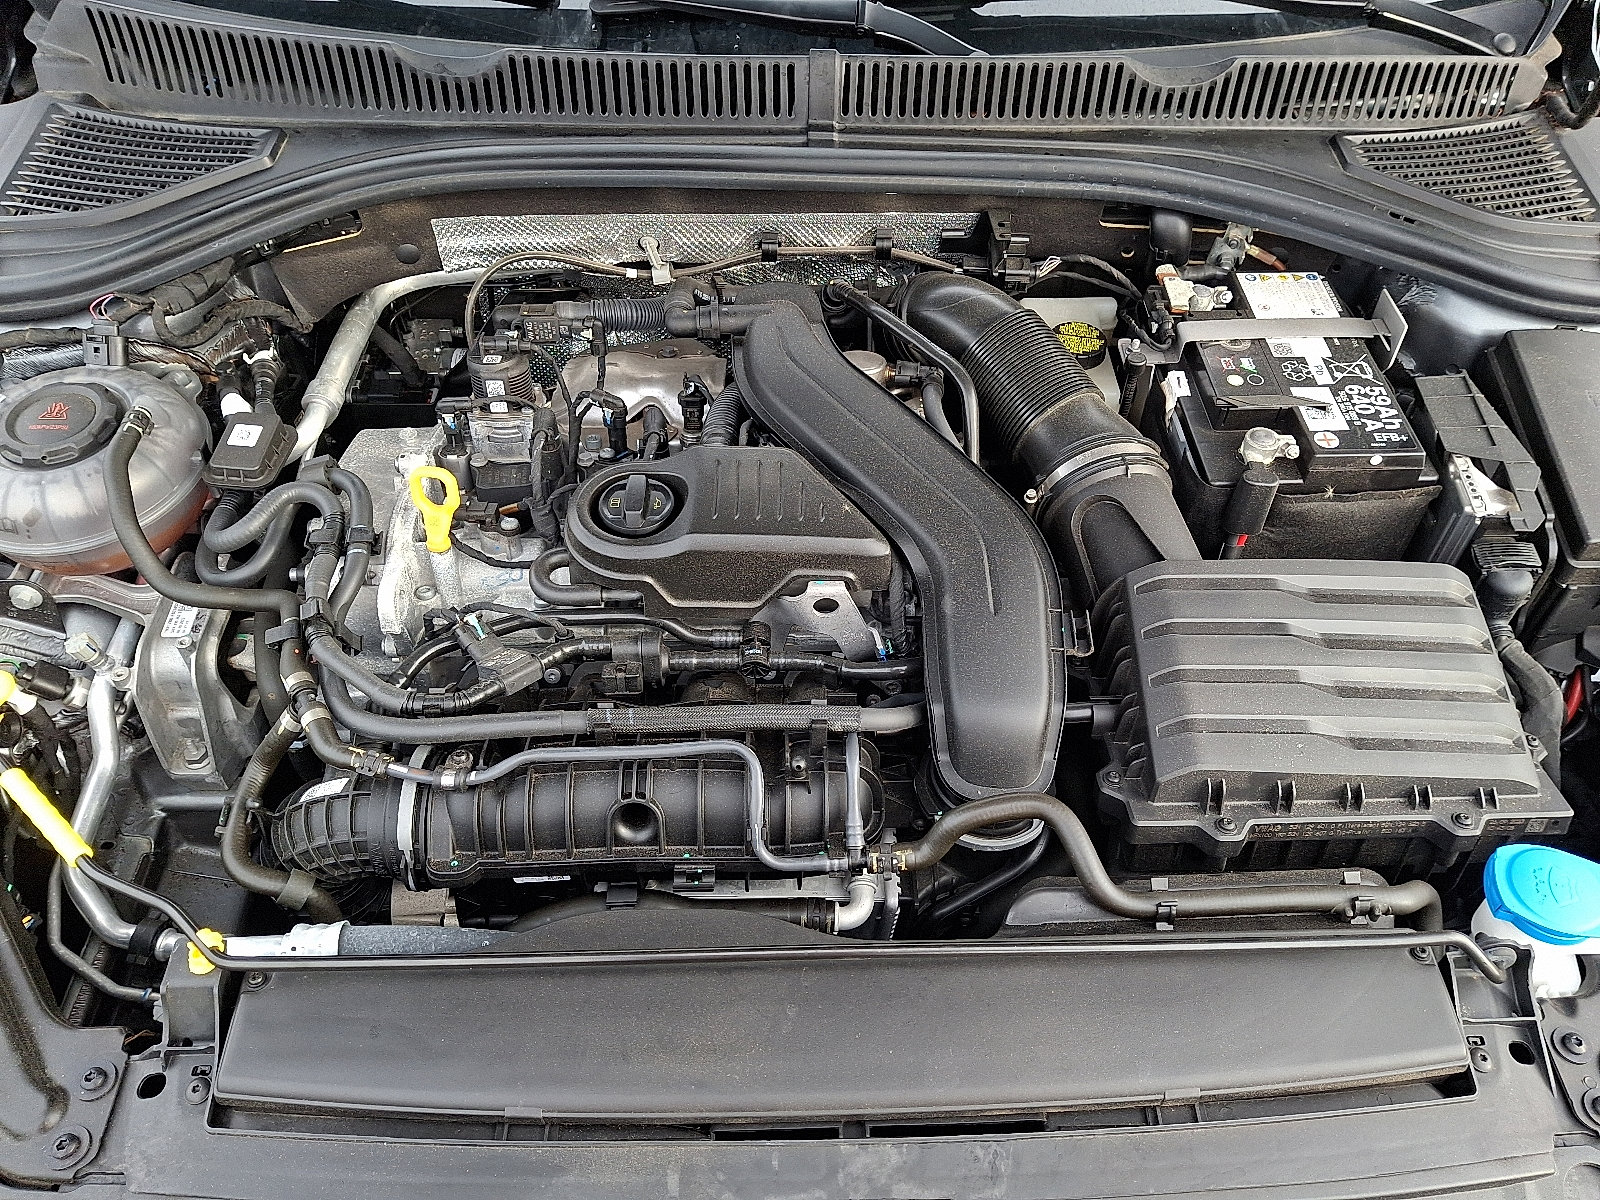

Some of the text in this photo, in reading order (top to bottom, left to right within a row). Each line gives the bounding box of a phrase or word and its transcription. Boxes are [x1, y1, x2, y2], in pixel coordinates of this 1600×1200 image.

[1344, 384, 1376, 415] 640
[1365, 386, 1403, 430] 59Ah
[1359, 418, 1385, 432] A
[1373, 432, 1409, 442] EFB+
